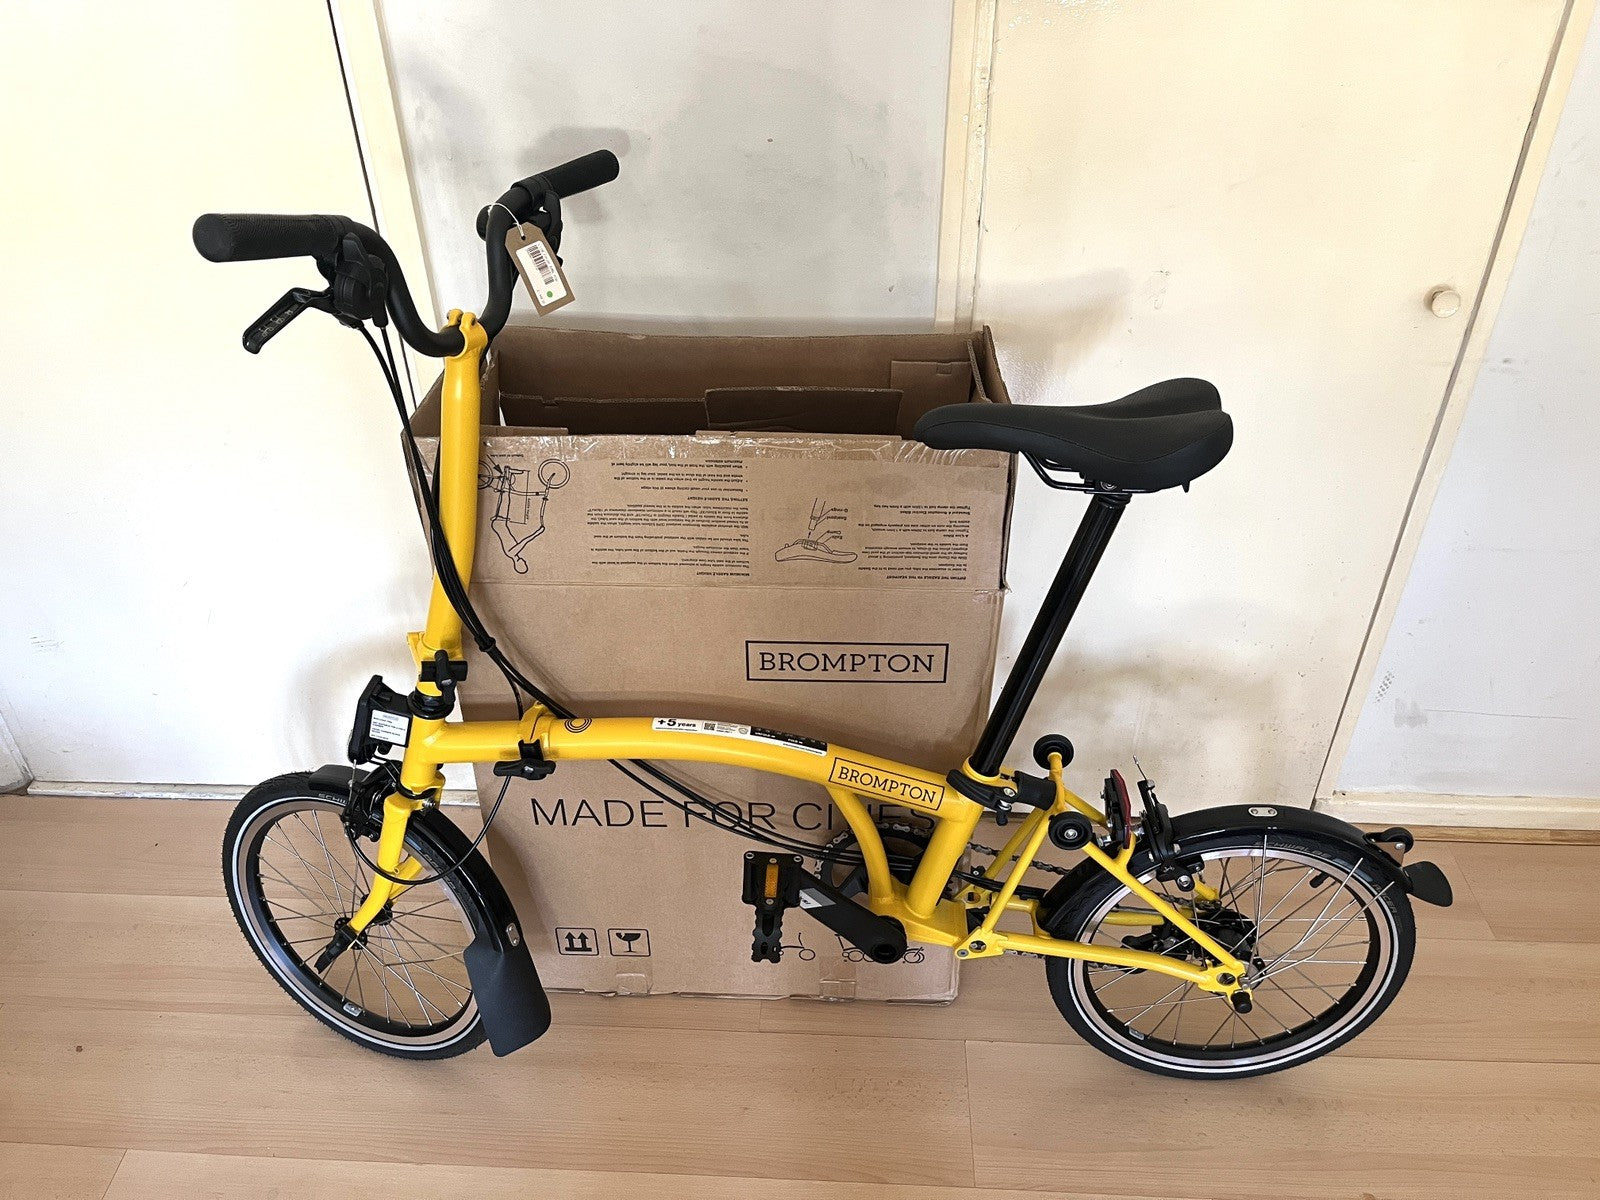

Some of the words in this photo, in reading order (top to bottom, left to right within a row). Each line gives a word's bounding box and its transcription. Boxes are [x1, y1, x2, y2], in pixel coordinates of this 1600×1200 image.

[759, 652, 934, 673] BROMPTON
[838, 766, 936, 804] BROMPTON
[531, 798, 668, 828] MADE
[684, 801, 776, 829] FOR
